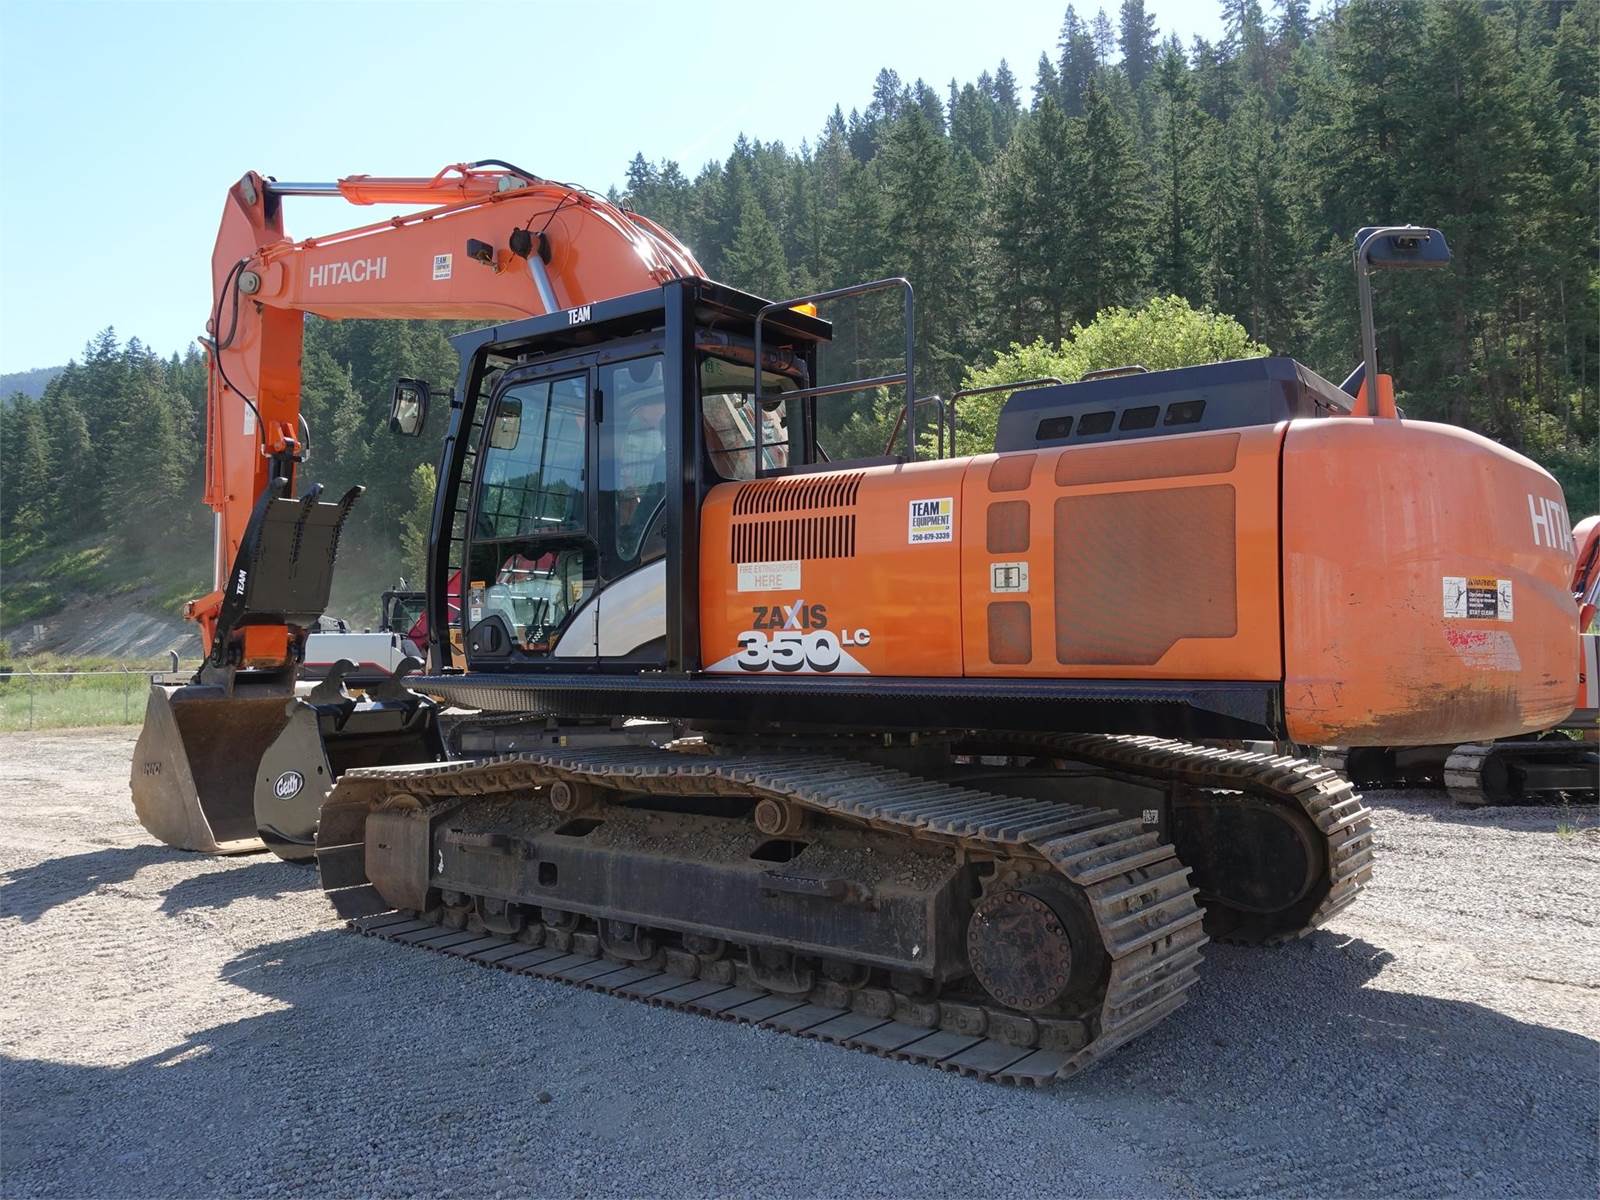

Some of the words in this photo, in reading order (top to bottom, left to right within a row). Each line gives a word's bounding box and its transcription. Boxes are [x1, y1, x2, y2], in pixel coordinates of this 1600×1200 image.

[309, 256, 387, 287] HITACHI
[567, 305, 591, 325] TEAM
[912, 501, 940, 516] TEAM
[912, 515, 950, 528] EQUIPMENT
[236, 569, 247, 595] TEAM
[755, 575, 783, 587] HERE
[752, 600, 828, 630] ZAXIS
[737, 630, 841, 673] 350
[841, 629, 871, 647] LC
